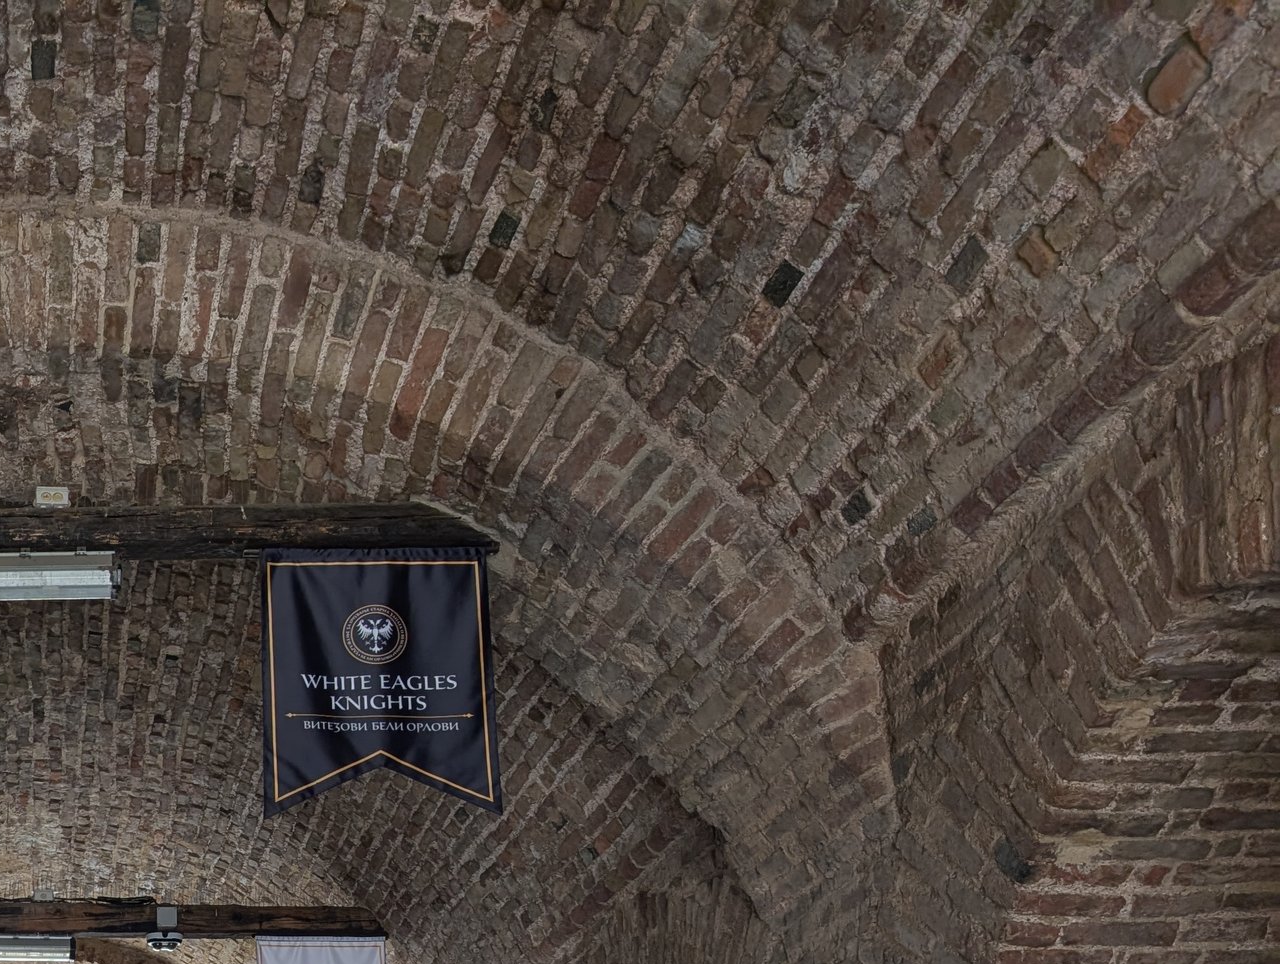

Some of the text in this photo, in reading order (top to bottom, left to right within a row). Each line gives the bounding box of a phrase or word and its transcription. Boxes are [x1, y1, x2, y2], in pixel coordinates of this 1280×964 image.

[300, 674, 458, 691] WHITE EAGLES
[330, 694, 427, 711] KNIGHTS
[303, 720, 459, 733] ВИТЕЗОВИ БЕЛИ ОРЛОВИ
